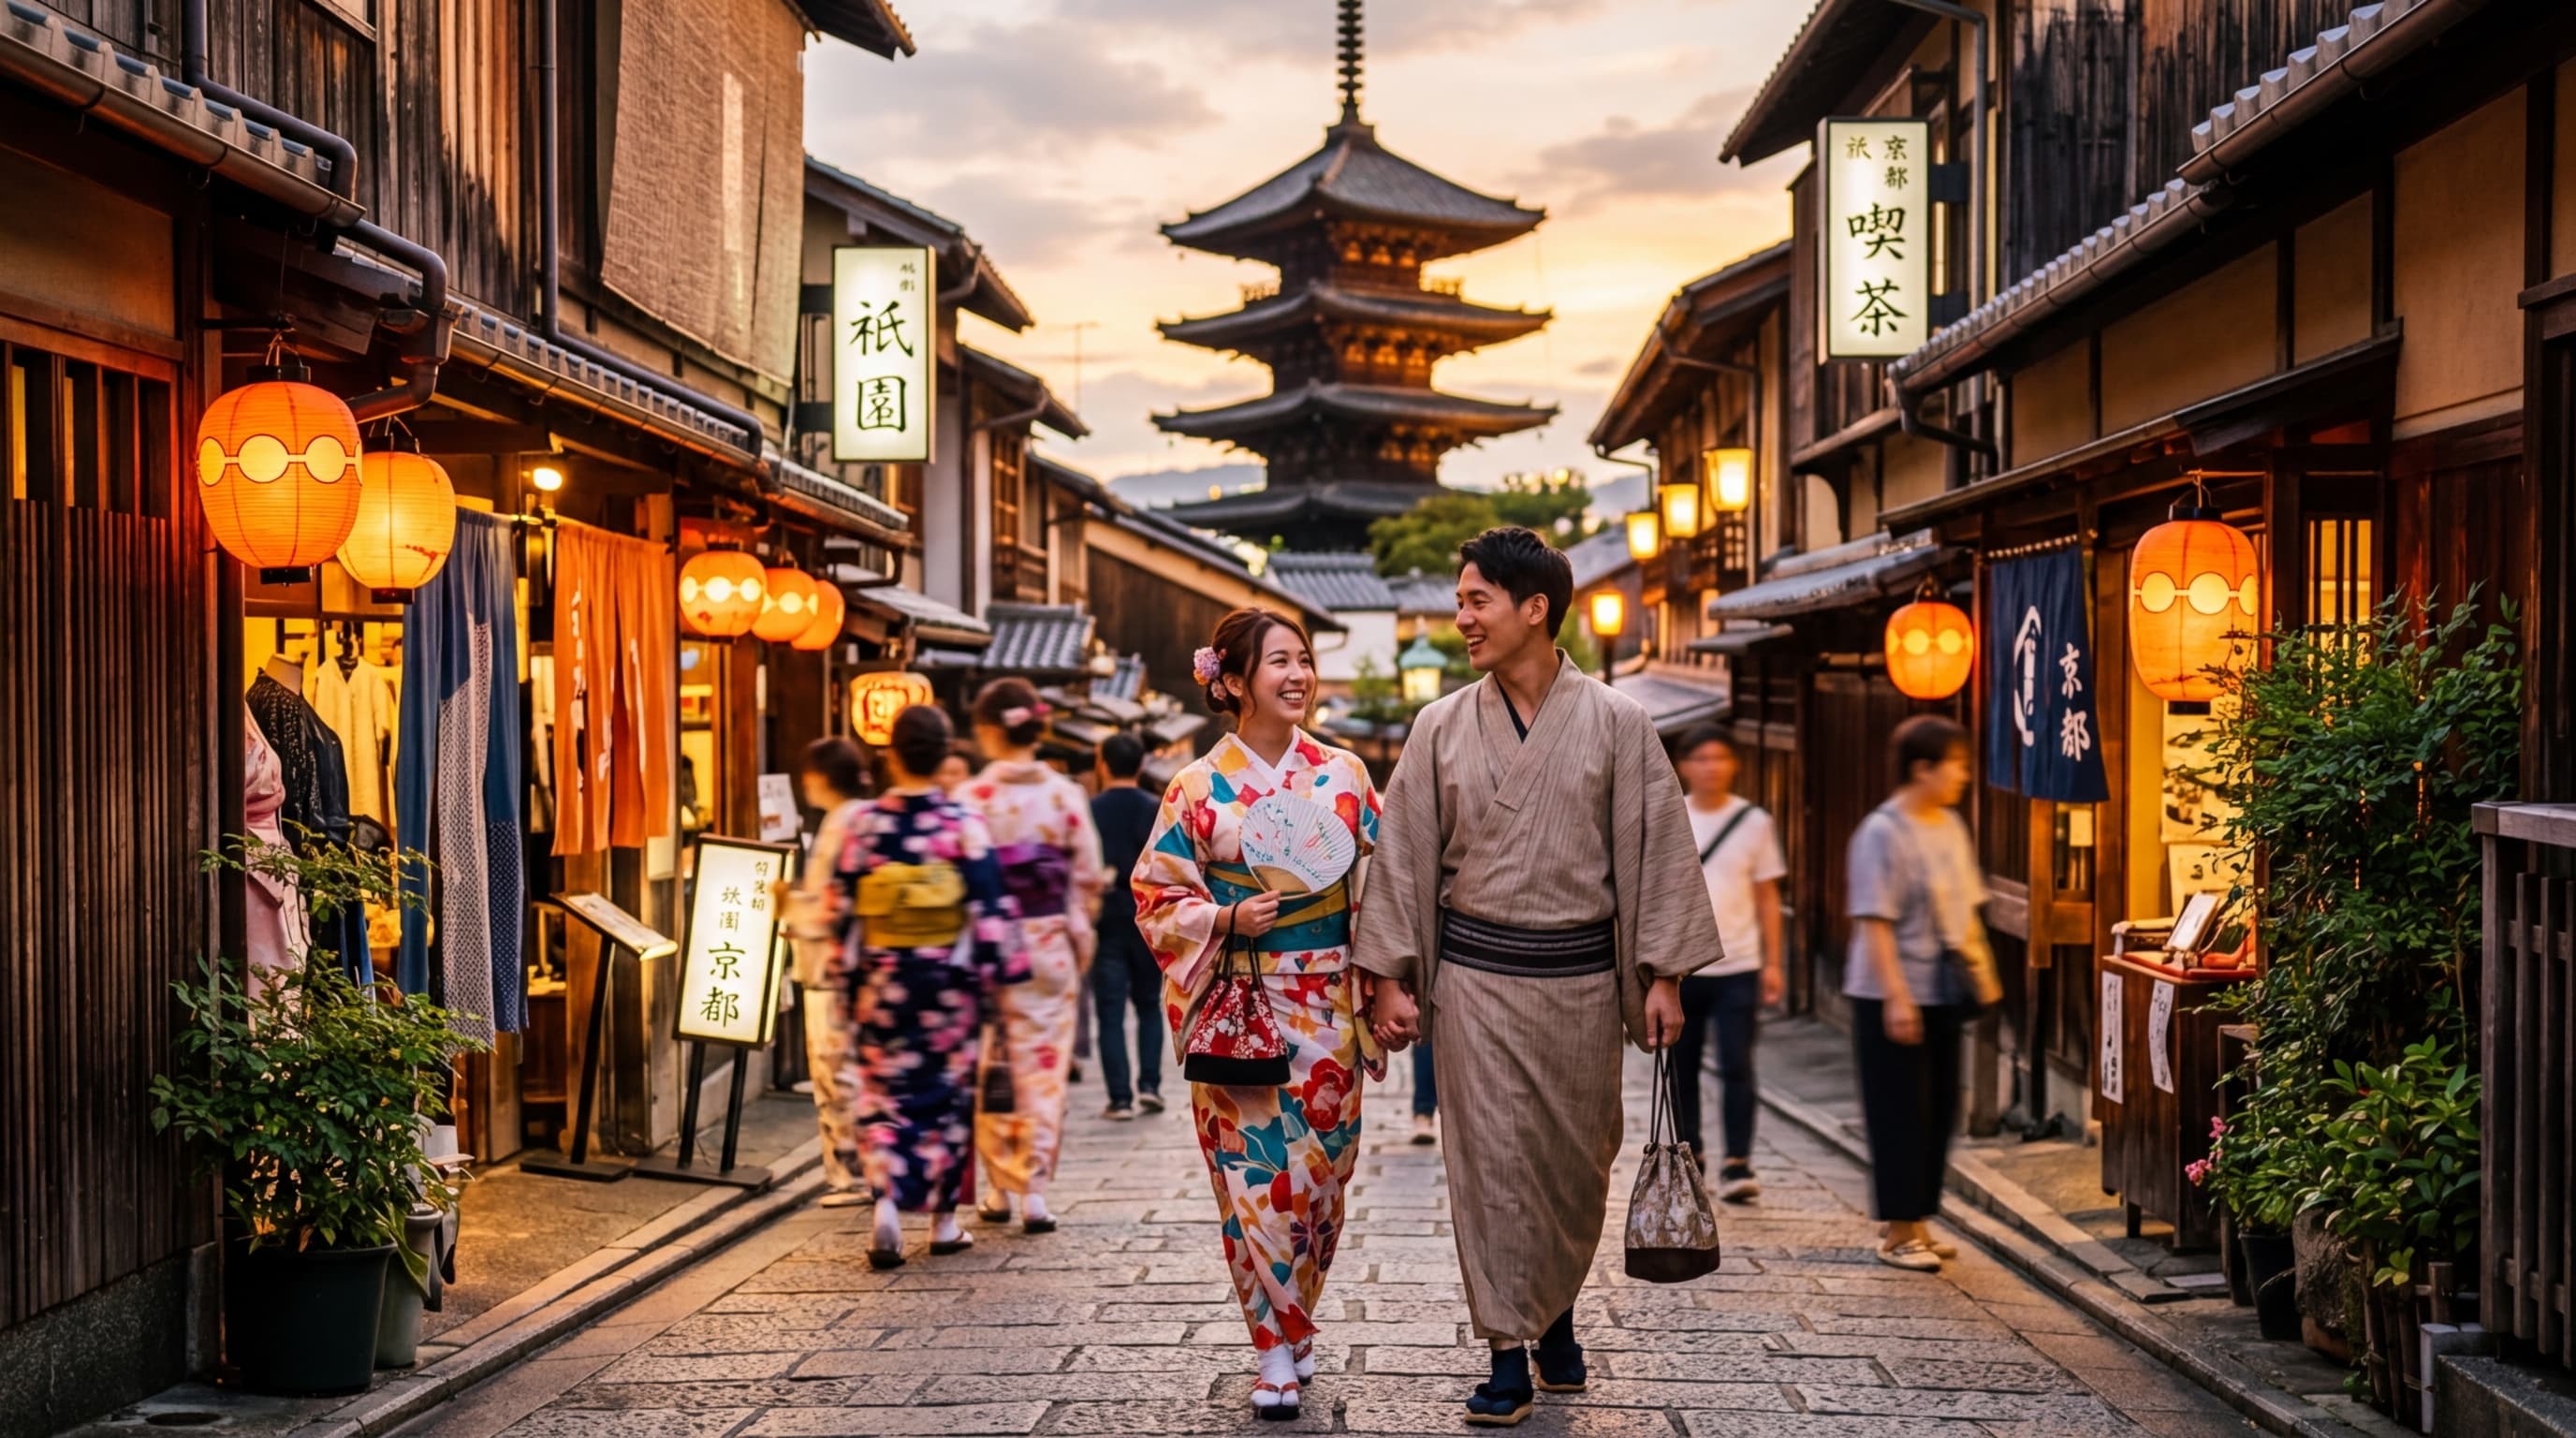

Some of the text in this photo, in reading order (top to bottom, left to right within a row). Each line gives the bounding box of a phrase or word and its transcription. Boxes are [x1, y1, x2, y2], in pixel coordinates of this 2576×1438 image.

[1883, 135, 1909, 190] 京都
[1847, 202, 1909, 338] 喫茶
[849, 300, 915, 433] 祇園
[2059, 641, 2091, 762] 京都
[699, 942, 746, 1028] 京都
